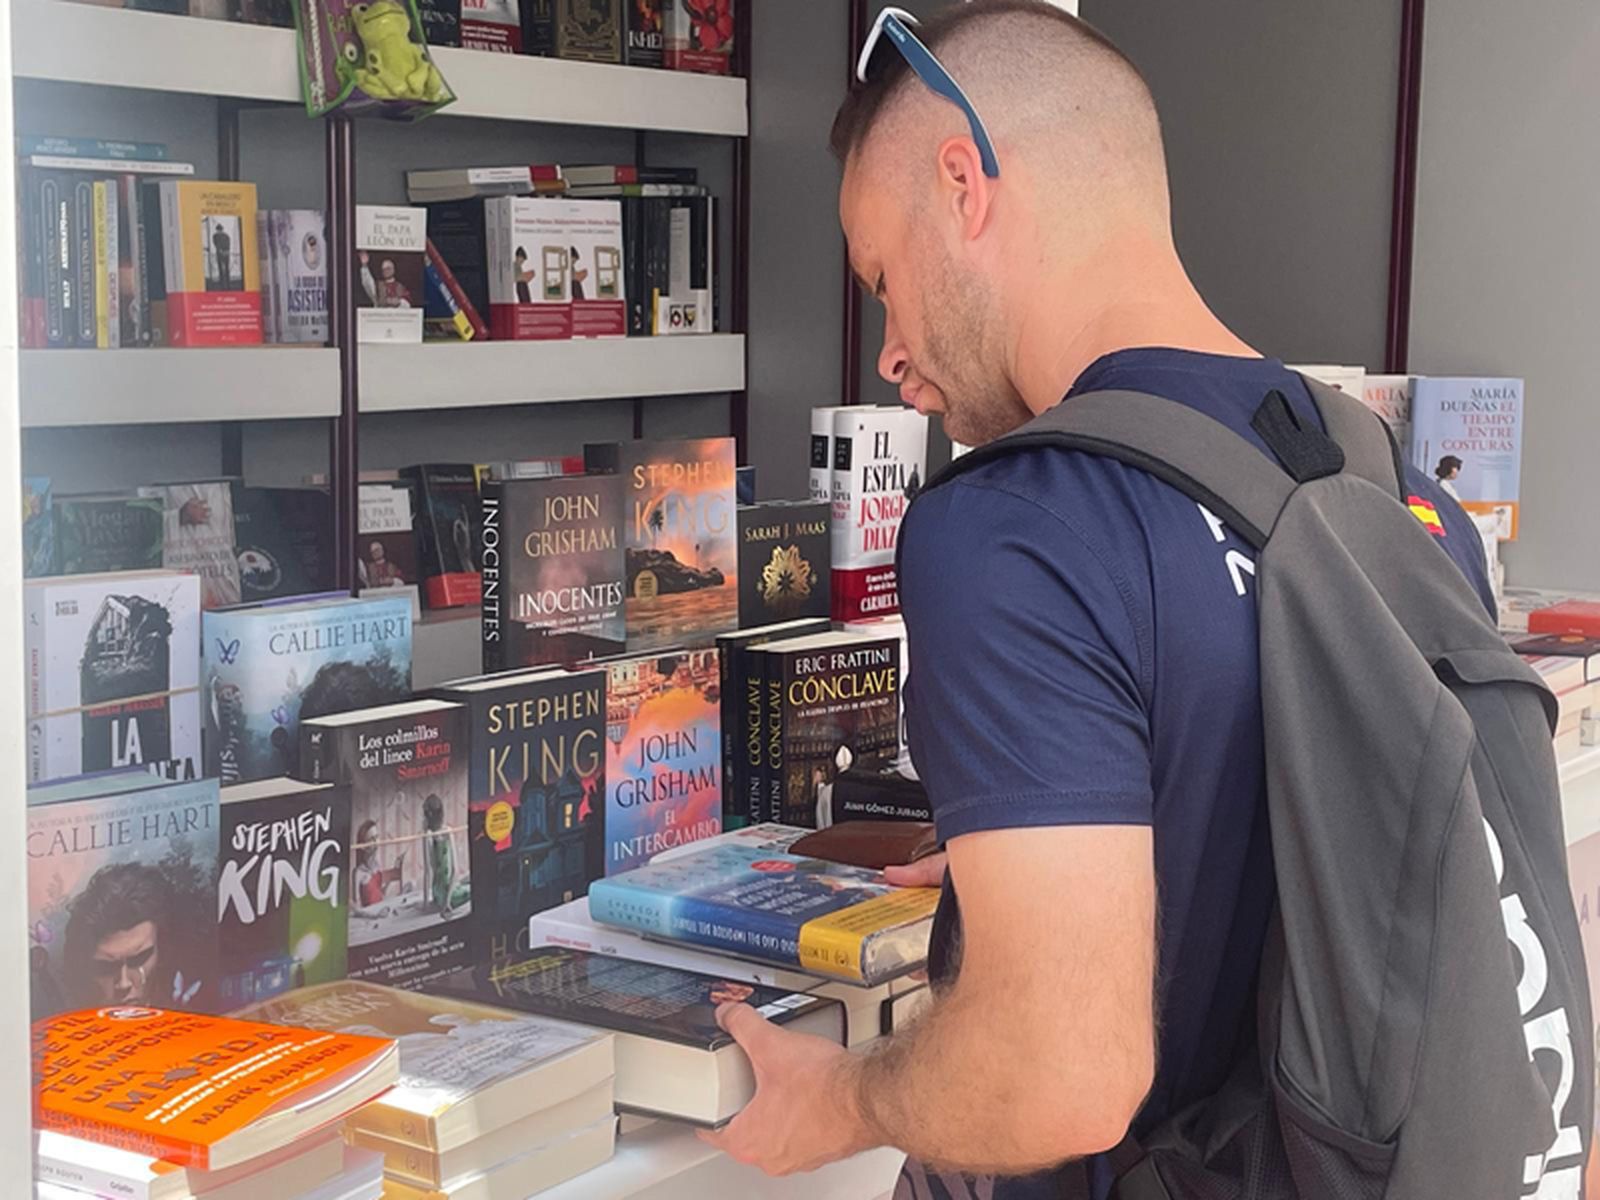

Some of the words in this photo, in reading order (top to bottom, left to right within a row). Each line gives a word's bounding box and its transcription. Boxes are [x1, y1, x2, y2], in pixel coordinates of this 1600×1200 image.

[367, 234, 396, 246] LEÓN
[373, 224, 385, 234] EL
[387, 223, 411, 234] PAPA
[287, 289, 329, 312] ASISTEN
[1365, 388, 1409, 401] ARÍA
[1440, 398, 1497, 412] DUEÑAS
[1470, 387, 1517, 400] MARÍA
[1460, 414, 1515, 425] TIEMPO
[1467, 427, 1514, 438] ENTRE
[874, 431, 892, 460] EL
[1441, 439, 1514, 451] COSTURAS
[633, 461, 731, 490] STEPHEN
[545, 494, 600, 529] JOHN
[634, 493, 729, 542] KING
[525, 526, 617, 558] GRISHAM
[745, 523, 781, 542] SARAH
[795, 521, 827, 537] MAAS
[482, 499, 500, 642] INOCENTES
[519, 582, 623, 617] INOCENTES
[269, 625, 346, 655] CALLIE
[352, 616, 408, 644] HART
[795, 655, 826, 675] ERIC
[831, 648, 890, 671] FRATTINI
[789, 667, 897, 706] CÓNCLAVE
[488, 690, 600, 734] STEPHEN
[748, 676, 762, 766] CÓNCLAVE
[769, 680, 782, 769] CÓNCLAVE
[112, 717, 143, 768] LA
[359, 732, 382, 752] Los
[385, 725, 438, 746] colmillos
[360, 750, 380, 769] del
[383, 747, 413, 766] lince
[416, 741, 451, 759] Karin
[639, 727, 698, 770] JOHN
[398, 758, 450, 779] Smirnoff
[489, 729, 600, 797] KING
[615, 764, 717, 809] GRISHAM
[26, 819, 133, 859] CALLIE
[142, 803, 214, 841] HART
[231, 805, 332, 853] STEPHEN
[664, 811, 676, 827] EL
[613, 818, 721, 861] INTERCAMBIO
[217, 838, 341, 925] KING
[40, 1073, 90, 1093] TE
[85, 1022, 214, 1071] IMPORTE
[72, 1069, 146, 1103] UNA
[192, 1084, 262, 1125] MARK
[260, 1042, 354, 1085] MANSON
